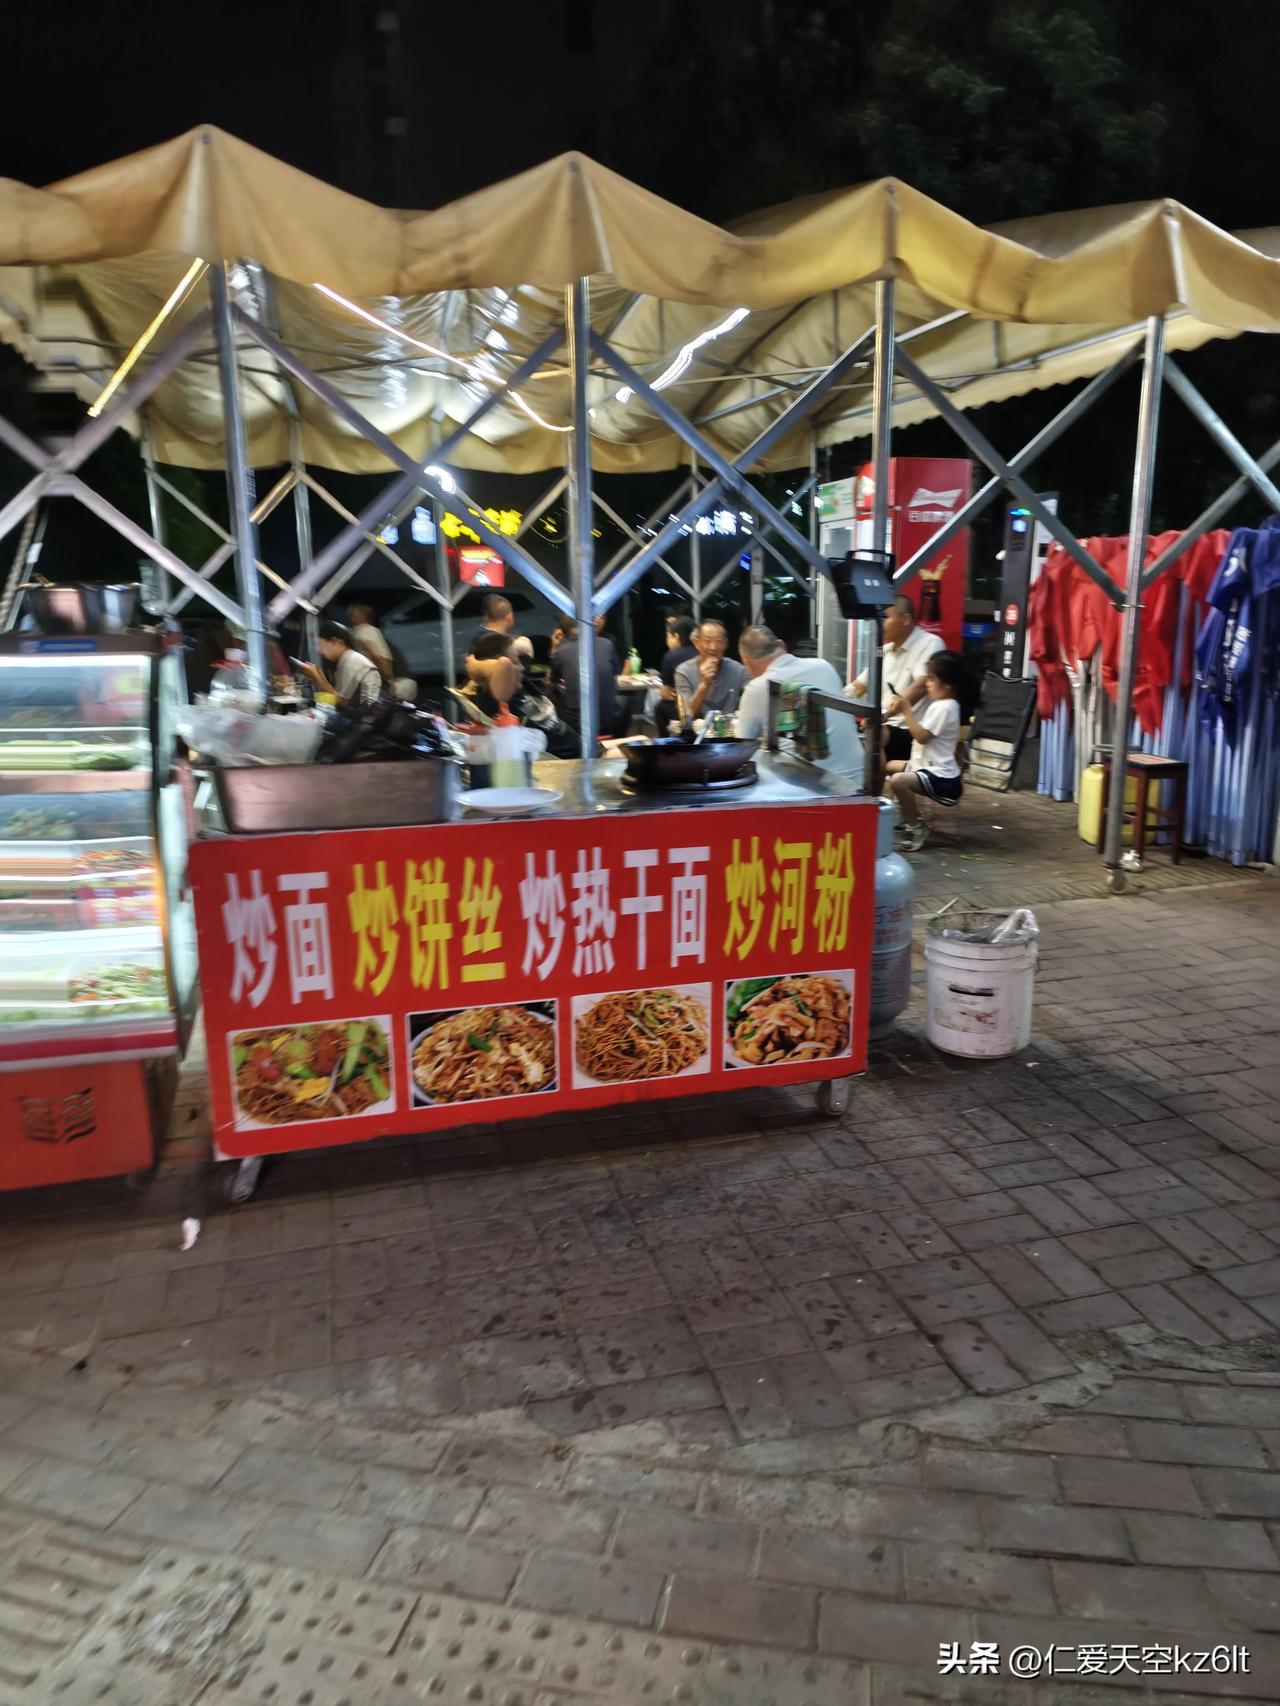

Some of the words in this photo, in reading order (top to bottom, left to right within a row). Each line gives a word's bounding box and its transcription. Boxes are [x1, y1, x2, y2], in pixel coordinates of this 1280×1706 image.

[223, 869, 333, 1008] 炒面
[348, 857, 507, 996] 炒饼丝
[519, 846, 711, 981] 炒热干面
[723, 832, 855, 961] 炒河粉
